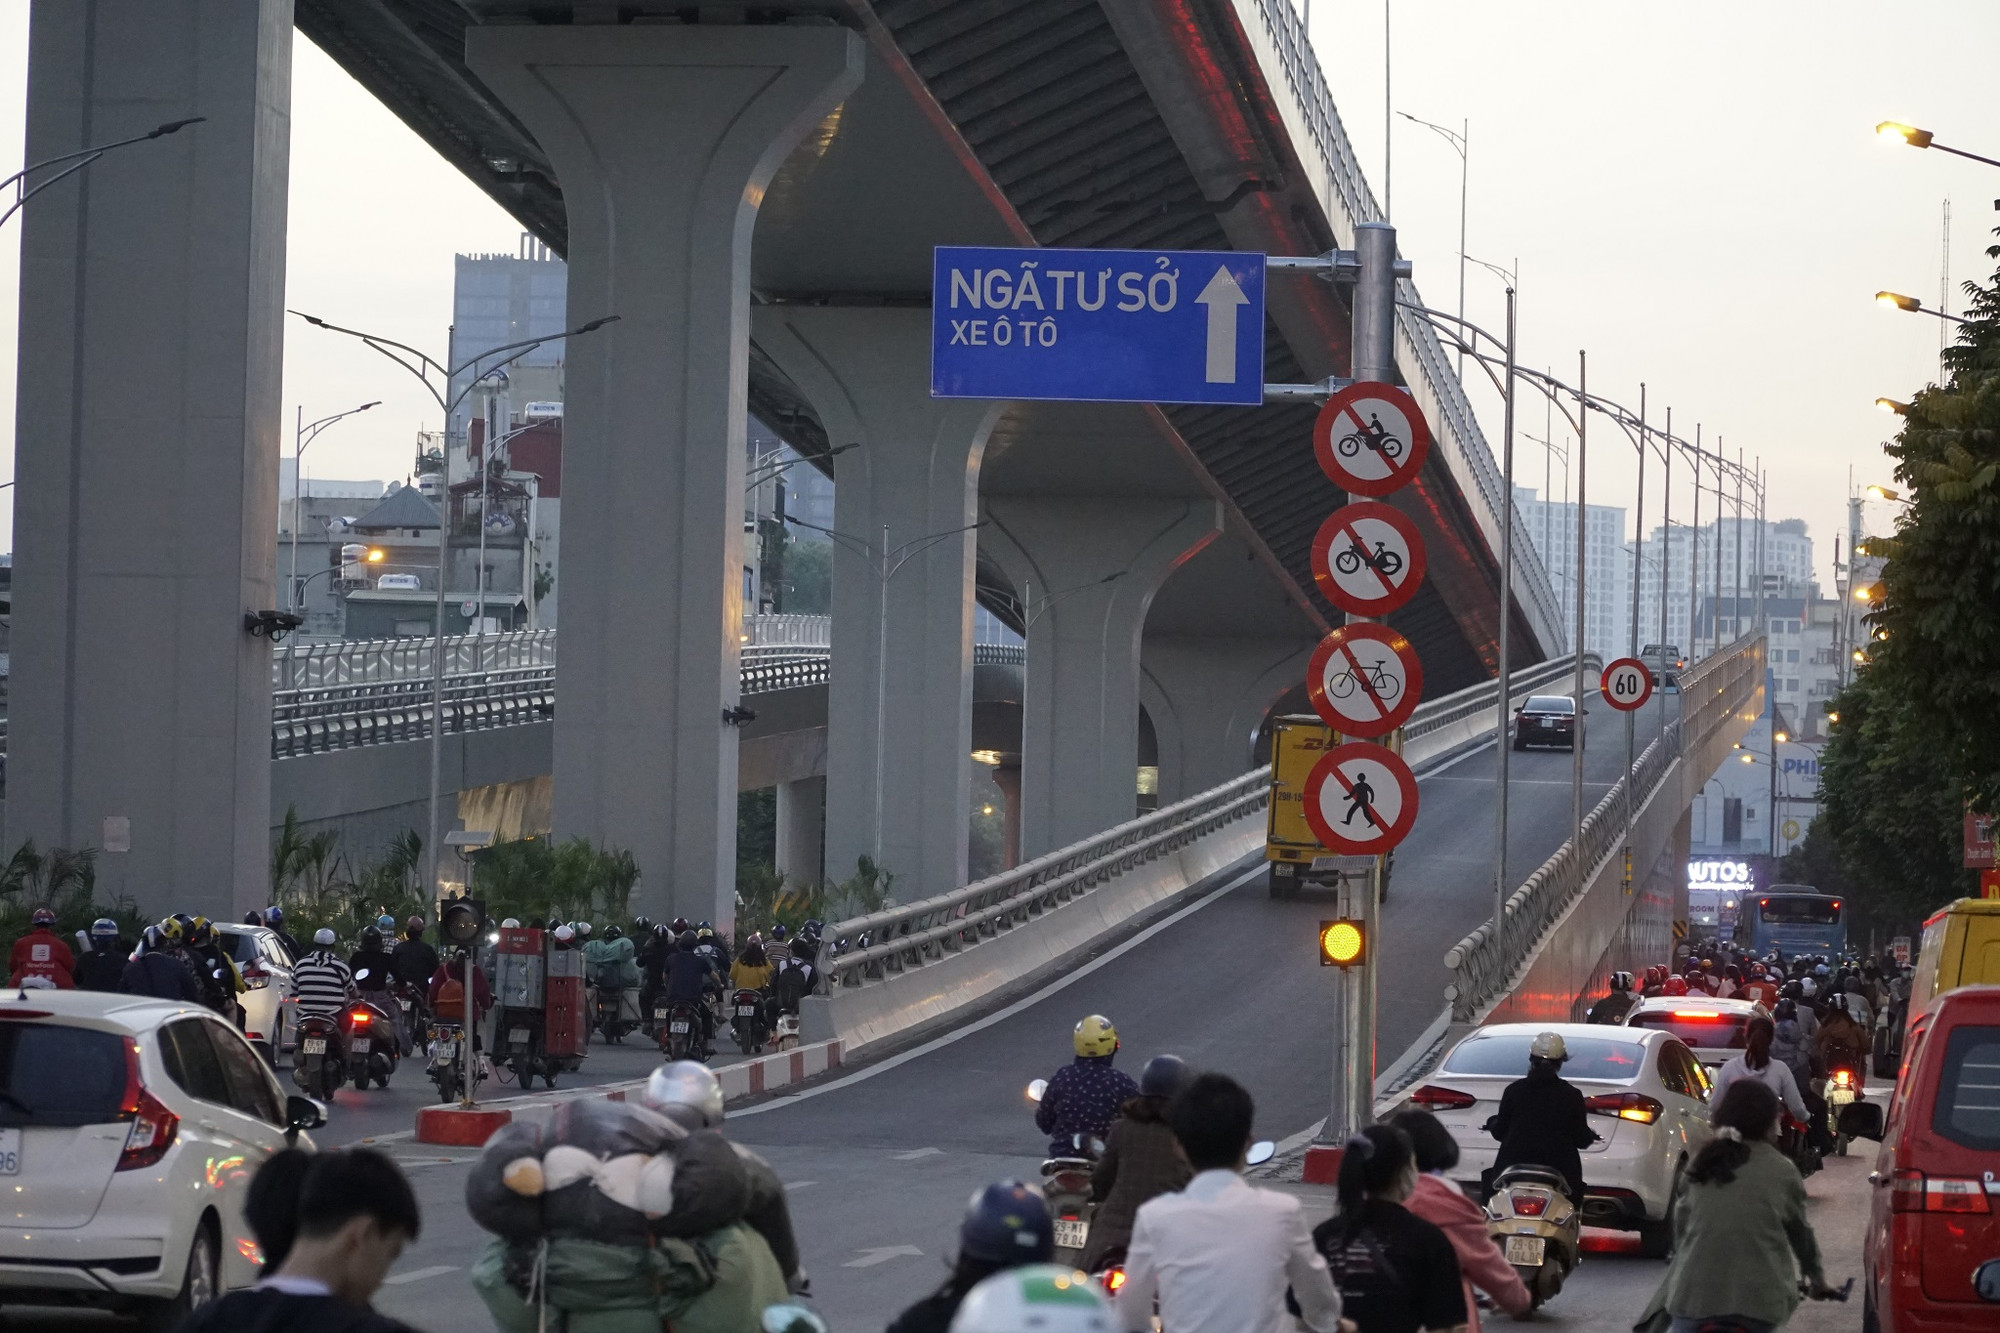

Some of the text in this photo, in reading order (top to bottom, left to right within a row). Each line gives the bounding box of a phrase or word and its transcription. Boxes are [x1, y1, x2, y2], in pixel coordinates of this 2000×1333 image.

[950, 256, 1180, 313] NGÃ TƯ SỞ
[949, 315, 1058, 347] XE Ô TÔ
[1615, 674, 1637, 695] 60
